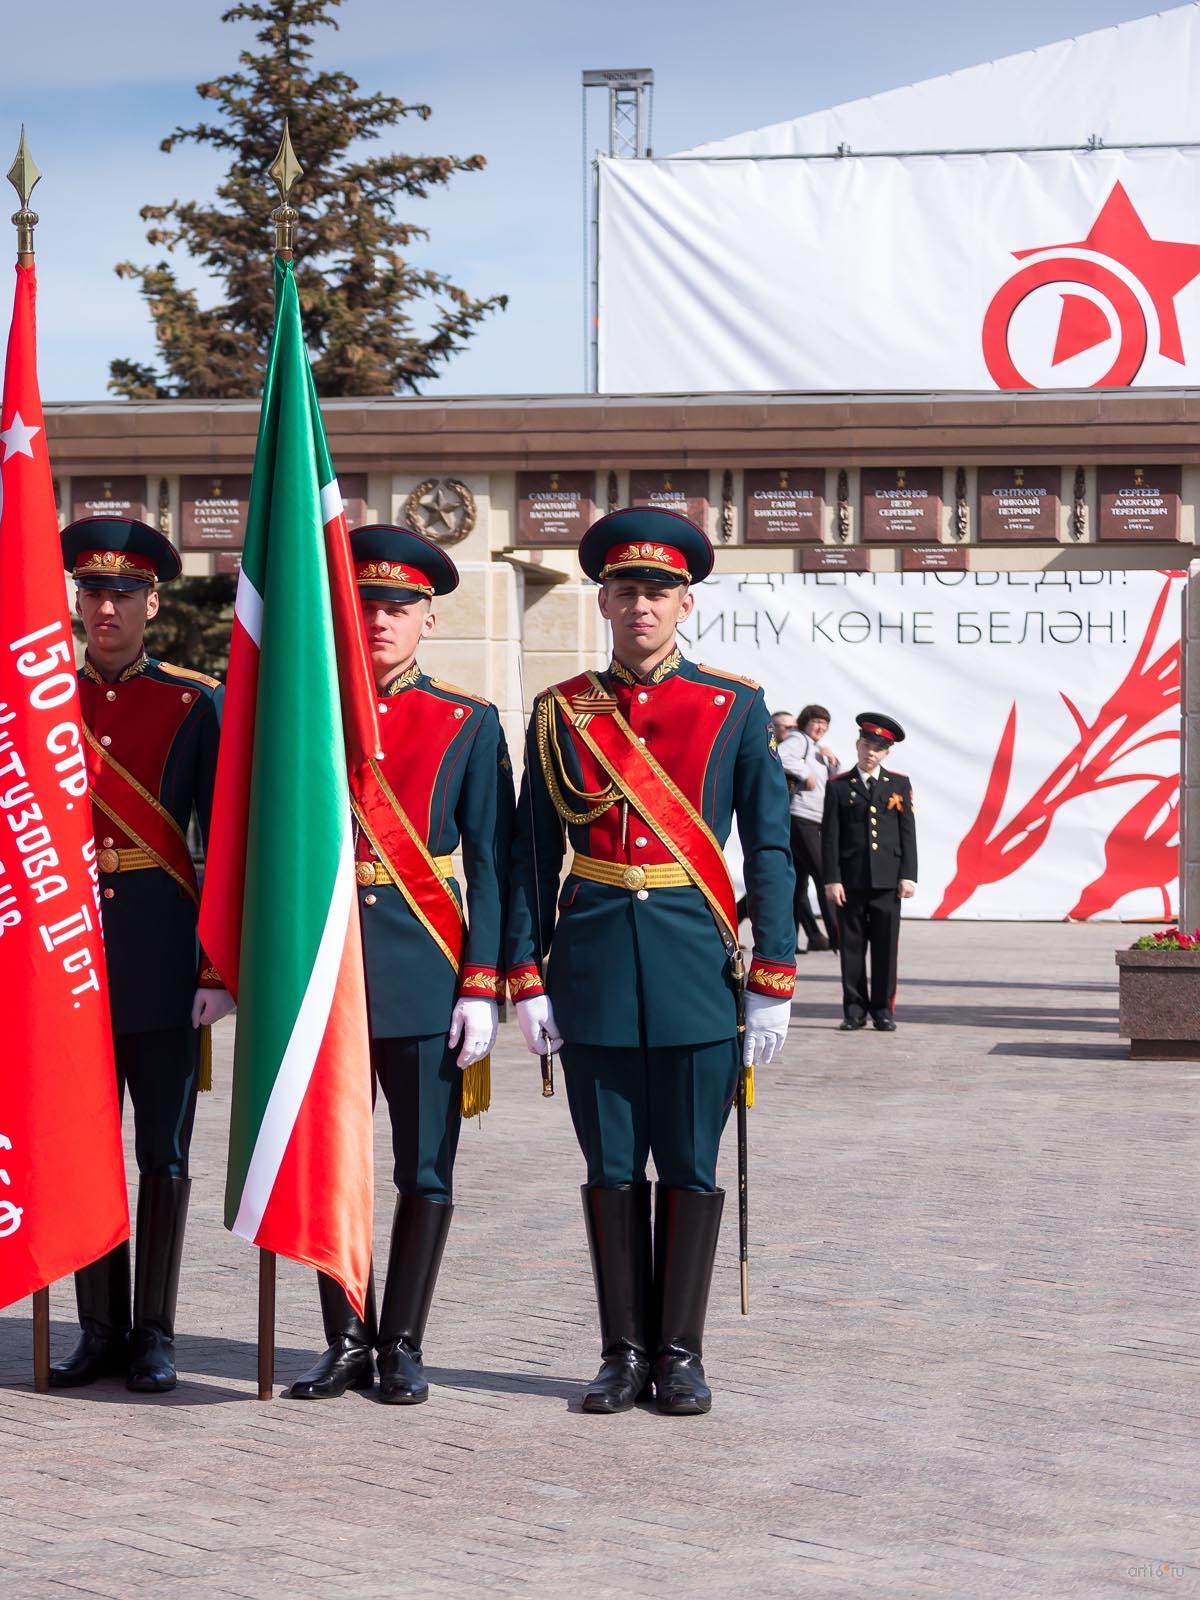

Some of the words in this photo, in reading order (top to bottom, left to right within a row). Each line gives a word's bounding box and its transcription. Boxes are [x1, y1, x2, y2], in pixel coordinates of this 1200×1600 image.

[875, 489, 929, 498] САФРОНОВ
[1118, 488, 1160, 497] СЕРГЕЕВ
[1114, 498, 1164, 507] АЛЕКСАНДР
[1110, 507, 1168, 515] ТЕРЕНТЬЕВИЧ
[676, 610, 790, 649] ИҢҮ
[812, 610, 935, 644] КӨНЕ
[957, 610, 1127, 644] БЕЛӘН!
[9, 620, 77, 710] 150
